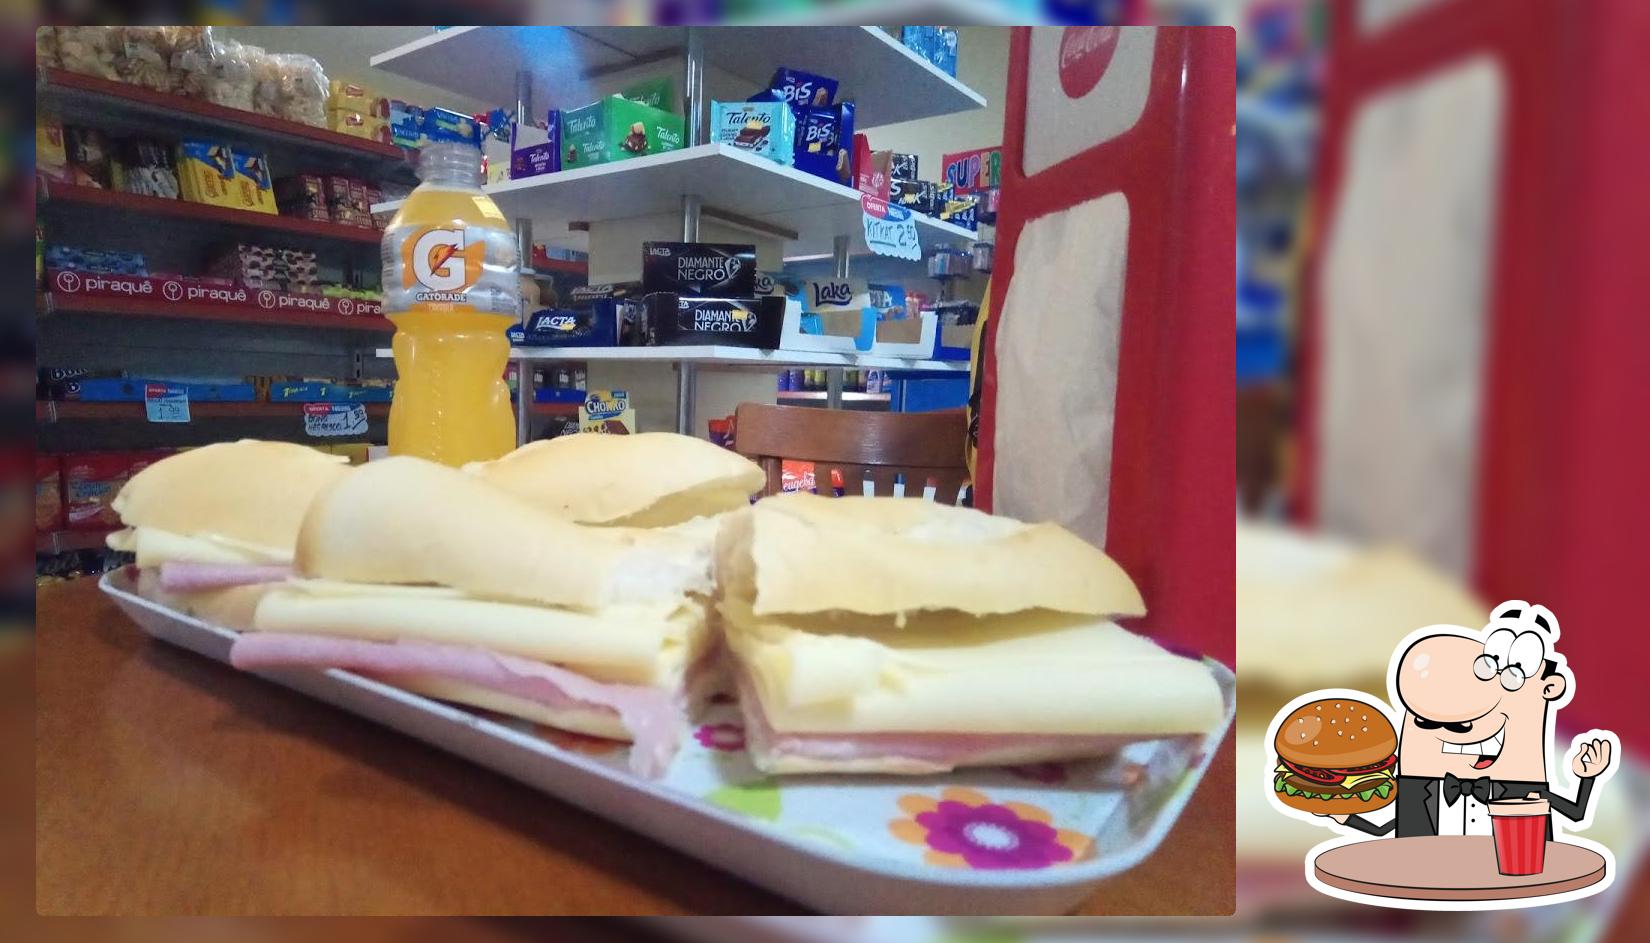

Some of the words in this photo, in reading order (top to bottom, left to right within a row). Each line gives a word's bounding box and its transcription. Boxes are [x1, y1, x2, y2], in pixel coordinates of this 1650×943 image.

[783, 82, 812, 102] BIS
[657, 126, 680, 144] Talento
[806, 123, 832, 142] BIS
[412, 229, 467, 292] G
[678, 257, 724, 269] DIAMANTE
[677, 269, 726, 281] NEGRO
[85, 276, 153, 295] piraquê
[187, 285, 247, 302] piraquê
[279, 293, 330, 311] piraquê
[416, 293, 467, 302] GATORADE
[813, 282, 852, 306] Laka
[695, 310, 739, 321] DIAMAN
